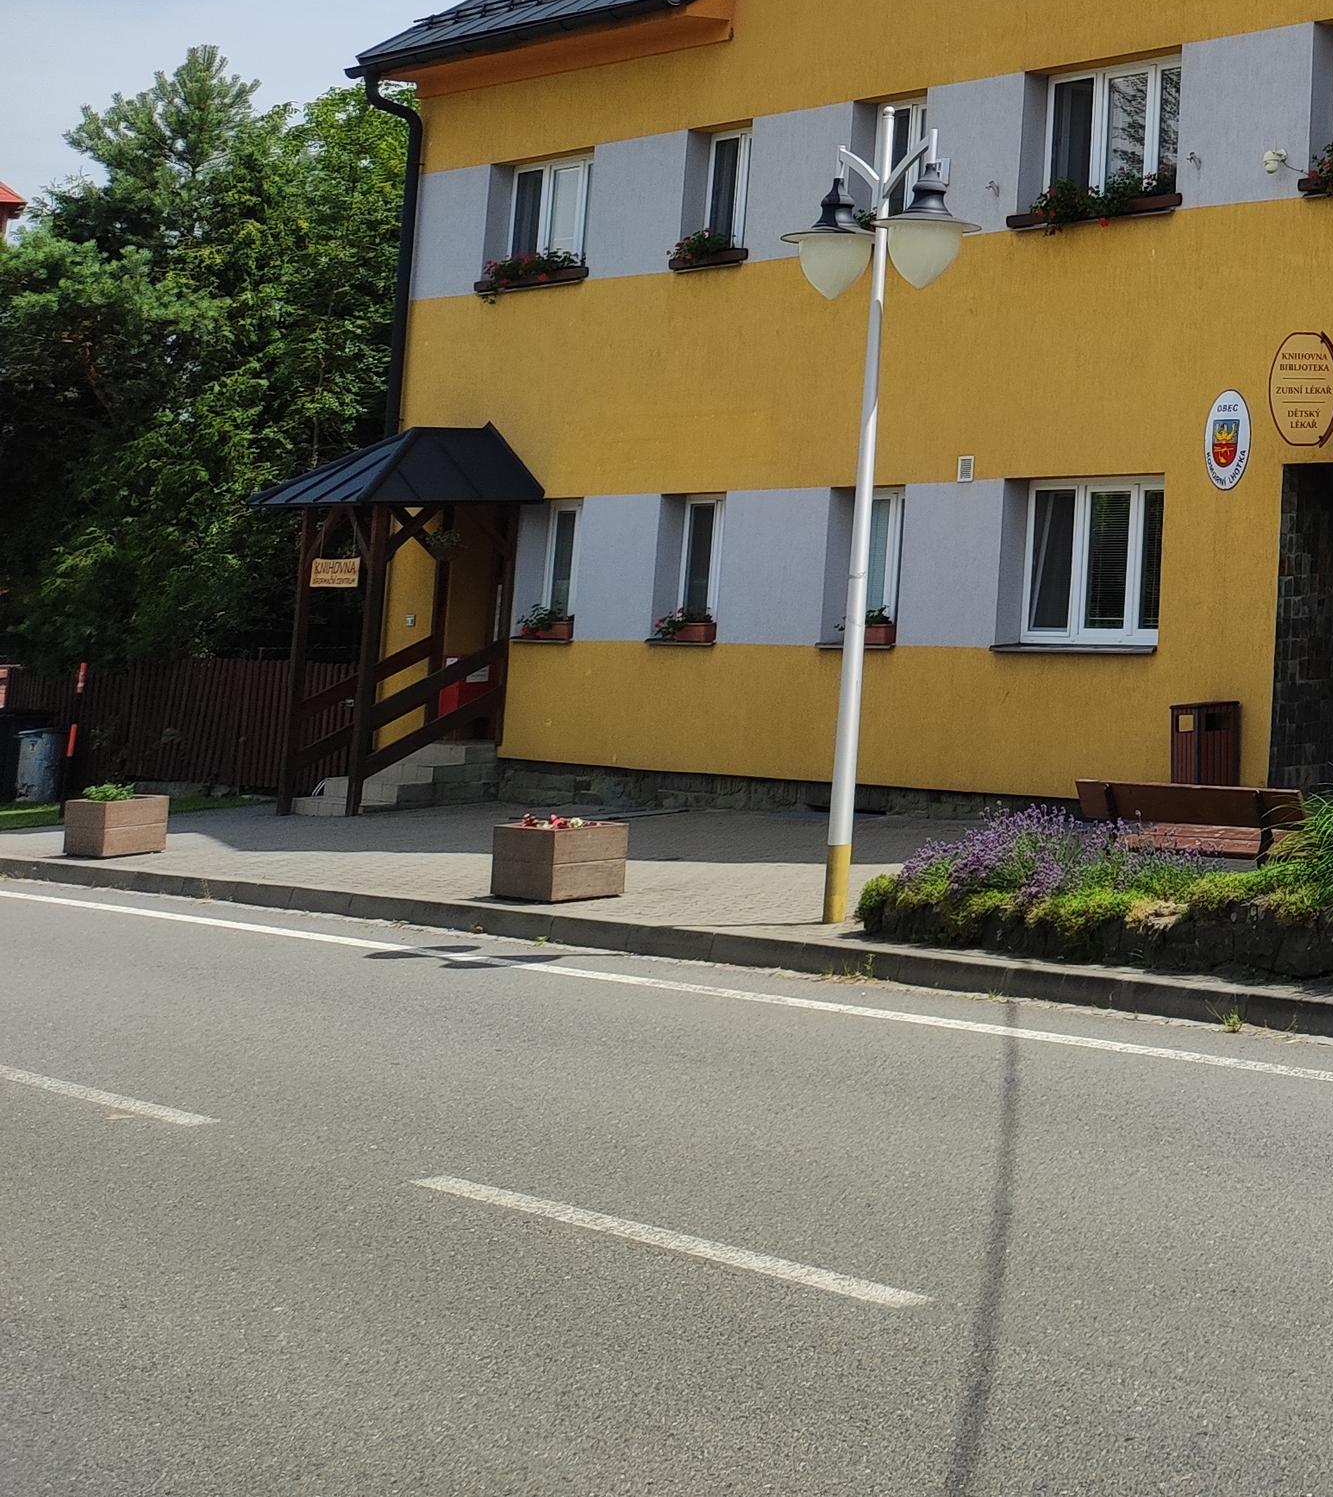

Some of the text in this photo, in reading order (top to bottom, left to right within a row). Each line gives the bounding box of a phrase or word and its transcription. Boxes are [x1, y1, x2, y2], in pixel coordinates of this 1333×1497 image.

[1281, 352, 1328, 361] KNIHOVNA
[1275, 384, 1332, 395] ZUBNÍ LÉKAŘ
[1216, 404, 1238, 413] OBEC
[1287, 408, 1321, 418] DĚTSKÝ
[1290, 419, 1318, 429] LÉKAŘ
[1228, 449, 1247, 484] LHOTKA
[314, 560, 356, 574] KNIHOVNA
